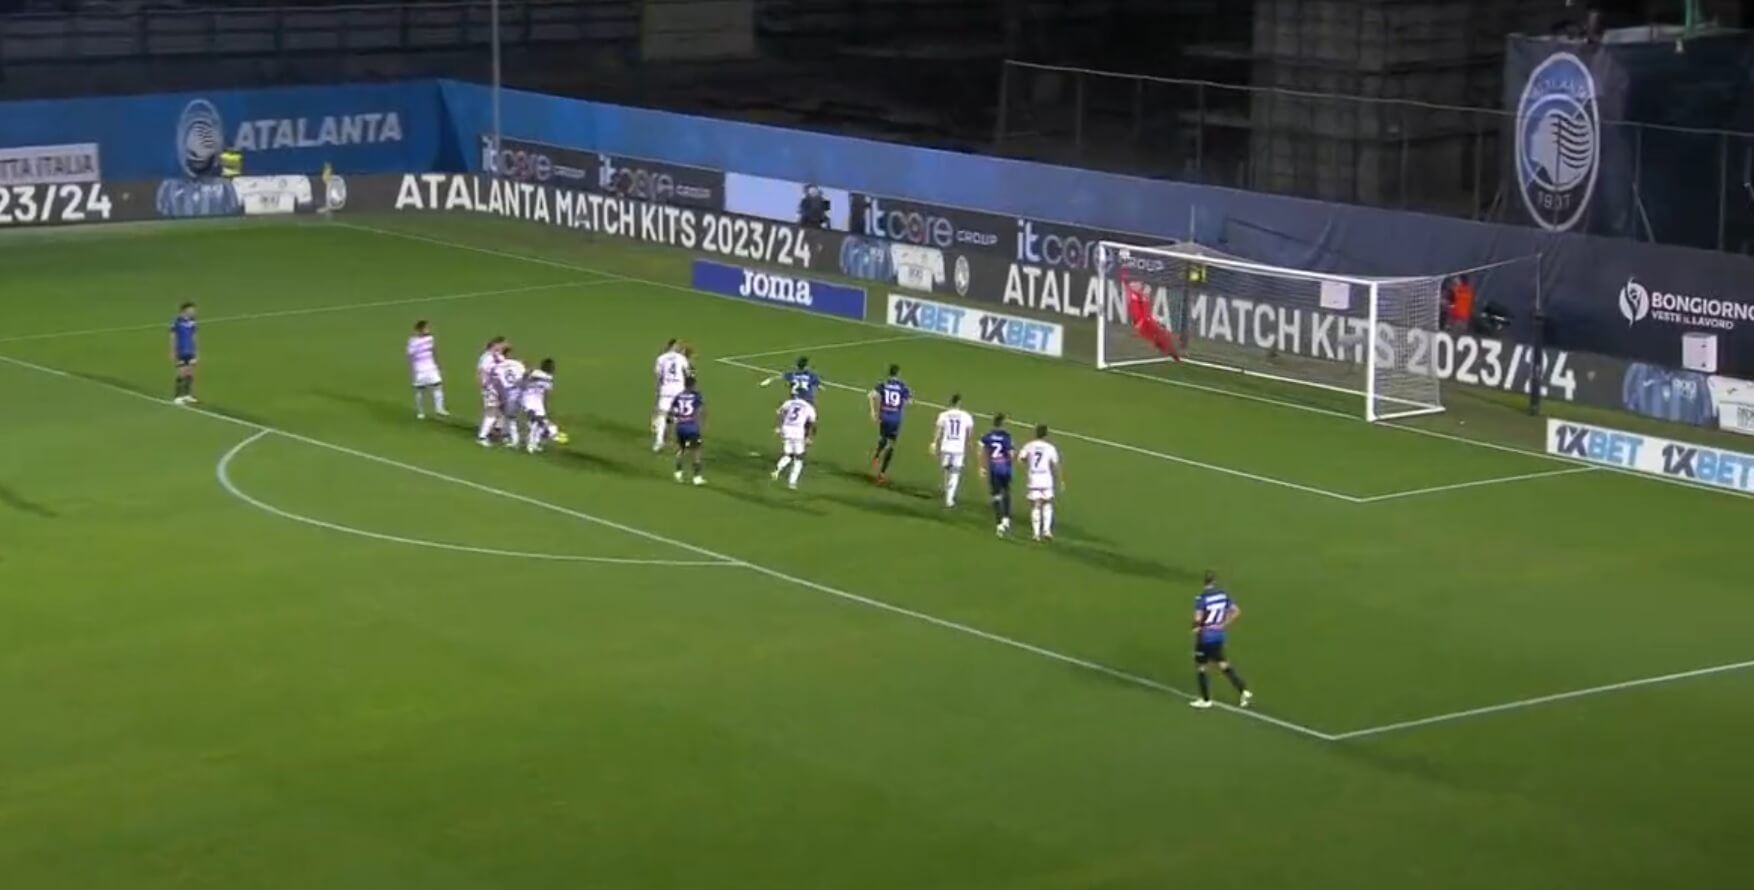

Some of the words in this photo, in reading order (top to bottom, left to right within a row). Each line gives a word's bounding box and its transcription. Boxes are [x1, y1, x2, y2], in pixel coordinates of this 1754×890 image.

[234, 112, 402, 151] ATALANTA
[395, 172, 549, 223] ATALANTA
[555, 188, 635, 237] MATCH
[641, 203, 696, 248] KITS
[702, 213, 811, 268] 2023/24
[956, 230, 998, 246] GROUP
[1119, 256, 1164, 272] ROUP
[894, 299, 966, 336] 1XBET
[979, 315, 1055, 352] 1XBET
[884, 390, 901, 407] 19
[950, 418, 961, 436] 11
[991, 442, 1002, 459] 2
[1555, 425, 1644, 467] 1XBET
[1034, 451, 1044, 469] 7
[1661, 443, 1754, 489] 1XBET
[1204, 601, 1227, 624] 77
